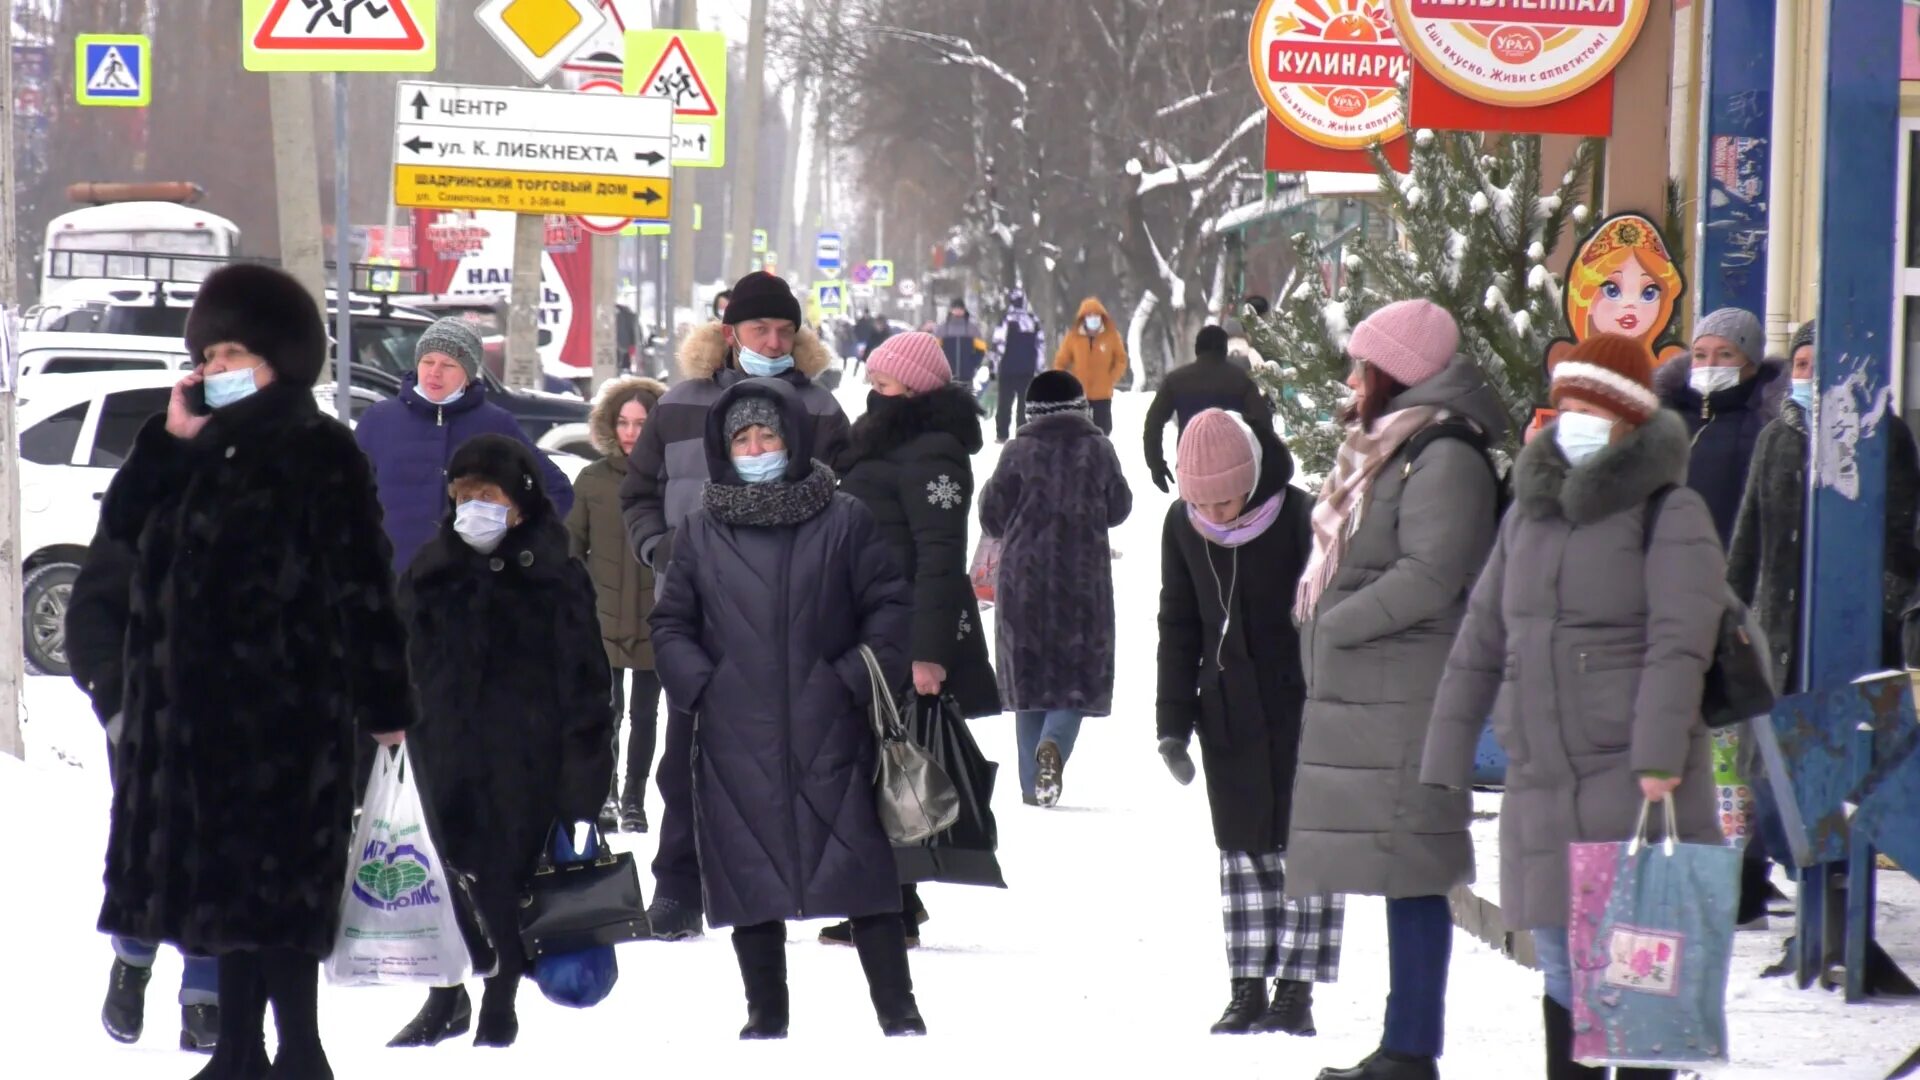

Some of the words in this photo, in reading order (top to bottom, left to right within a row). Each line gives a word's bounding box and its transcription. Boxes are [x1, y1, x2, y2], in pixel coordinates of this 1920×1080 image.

[1424, 22, 1443, 47] Ешь
[1443, 45, 1486, 78] вкусно.
[1490, 68, 1527, 83] Живи
[1530, 73, 1537, 82] с
[1539, 32, 1609, 81] аппетитом!
[1497, 35, 1534, 51] УРАЛ
[1278, 50, 1410, 79] КУЛИНАРИ
[440, 98, 507, 116] ЦЕНТР
[1279, 86, 1292, 104] Ешь
[1328, 120, 1356, 131] Живи
[438, 141, 466, 157] ул.
[473, 140, 490, 156] К.
[496, 142, 619, 162] ЛИБКНЕХТА
[415, 174, 512, 189] ШАДРИНСКИЙ
[517, 179, 592, 193] ТОРГОВЫЙ
[596, 182, 628, 195] ДОМ
